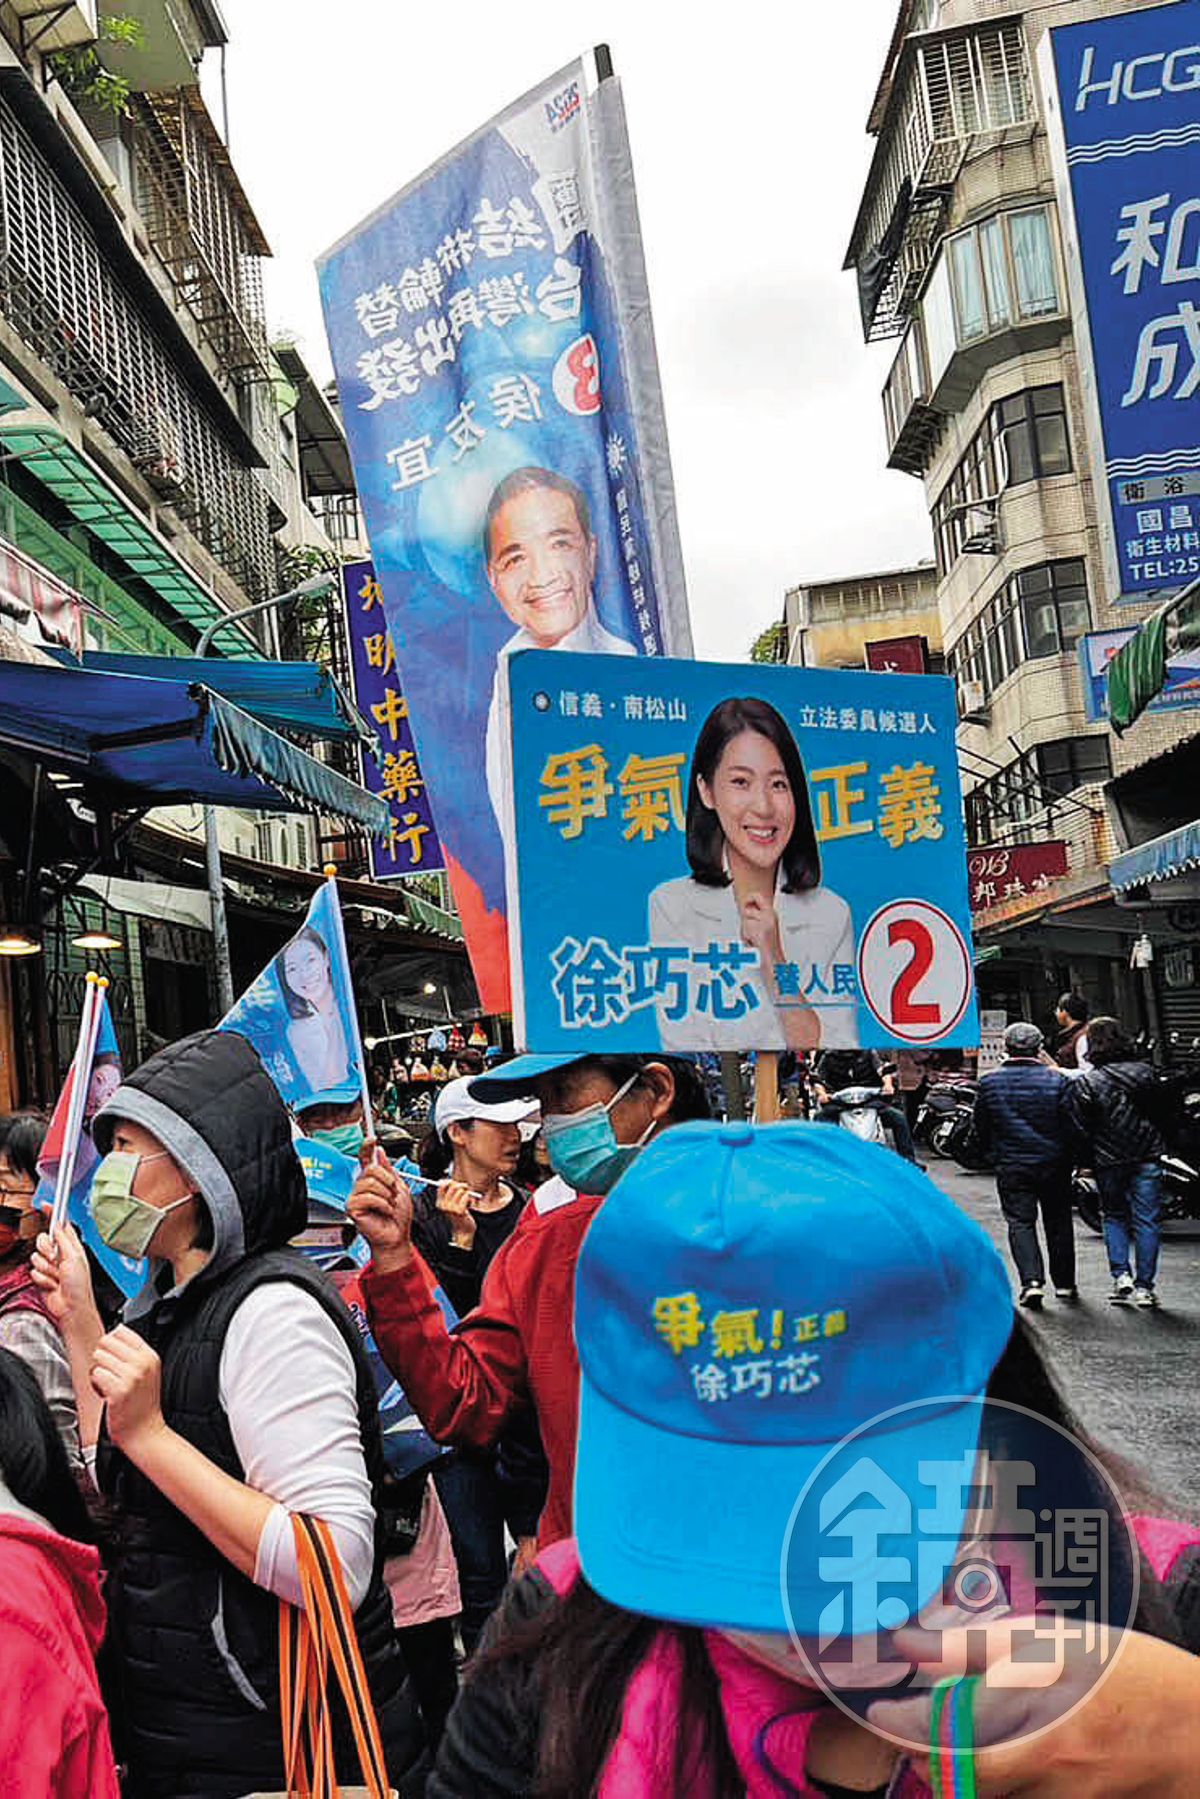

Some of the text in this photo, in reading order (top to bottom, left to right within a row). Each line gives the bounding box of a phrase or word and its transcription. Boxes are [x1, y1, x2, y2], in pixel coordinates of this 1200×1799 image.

[1075, 46, 1200, 111] HCG
[1110, 192, 1200, 408] 和成
[799, 705, 937, 734] 立法委員候選人
[539, 743, 945, 849] 爭氣 正義
[549, 936, 760, 1030] 徐巧芯
[887, 918, 942, 1025] 2
[690, 1351, 820, 1402] 徐巧芯
